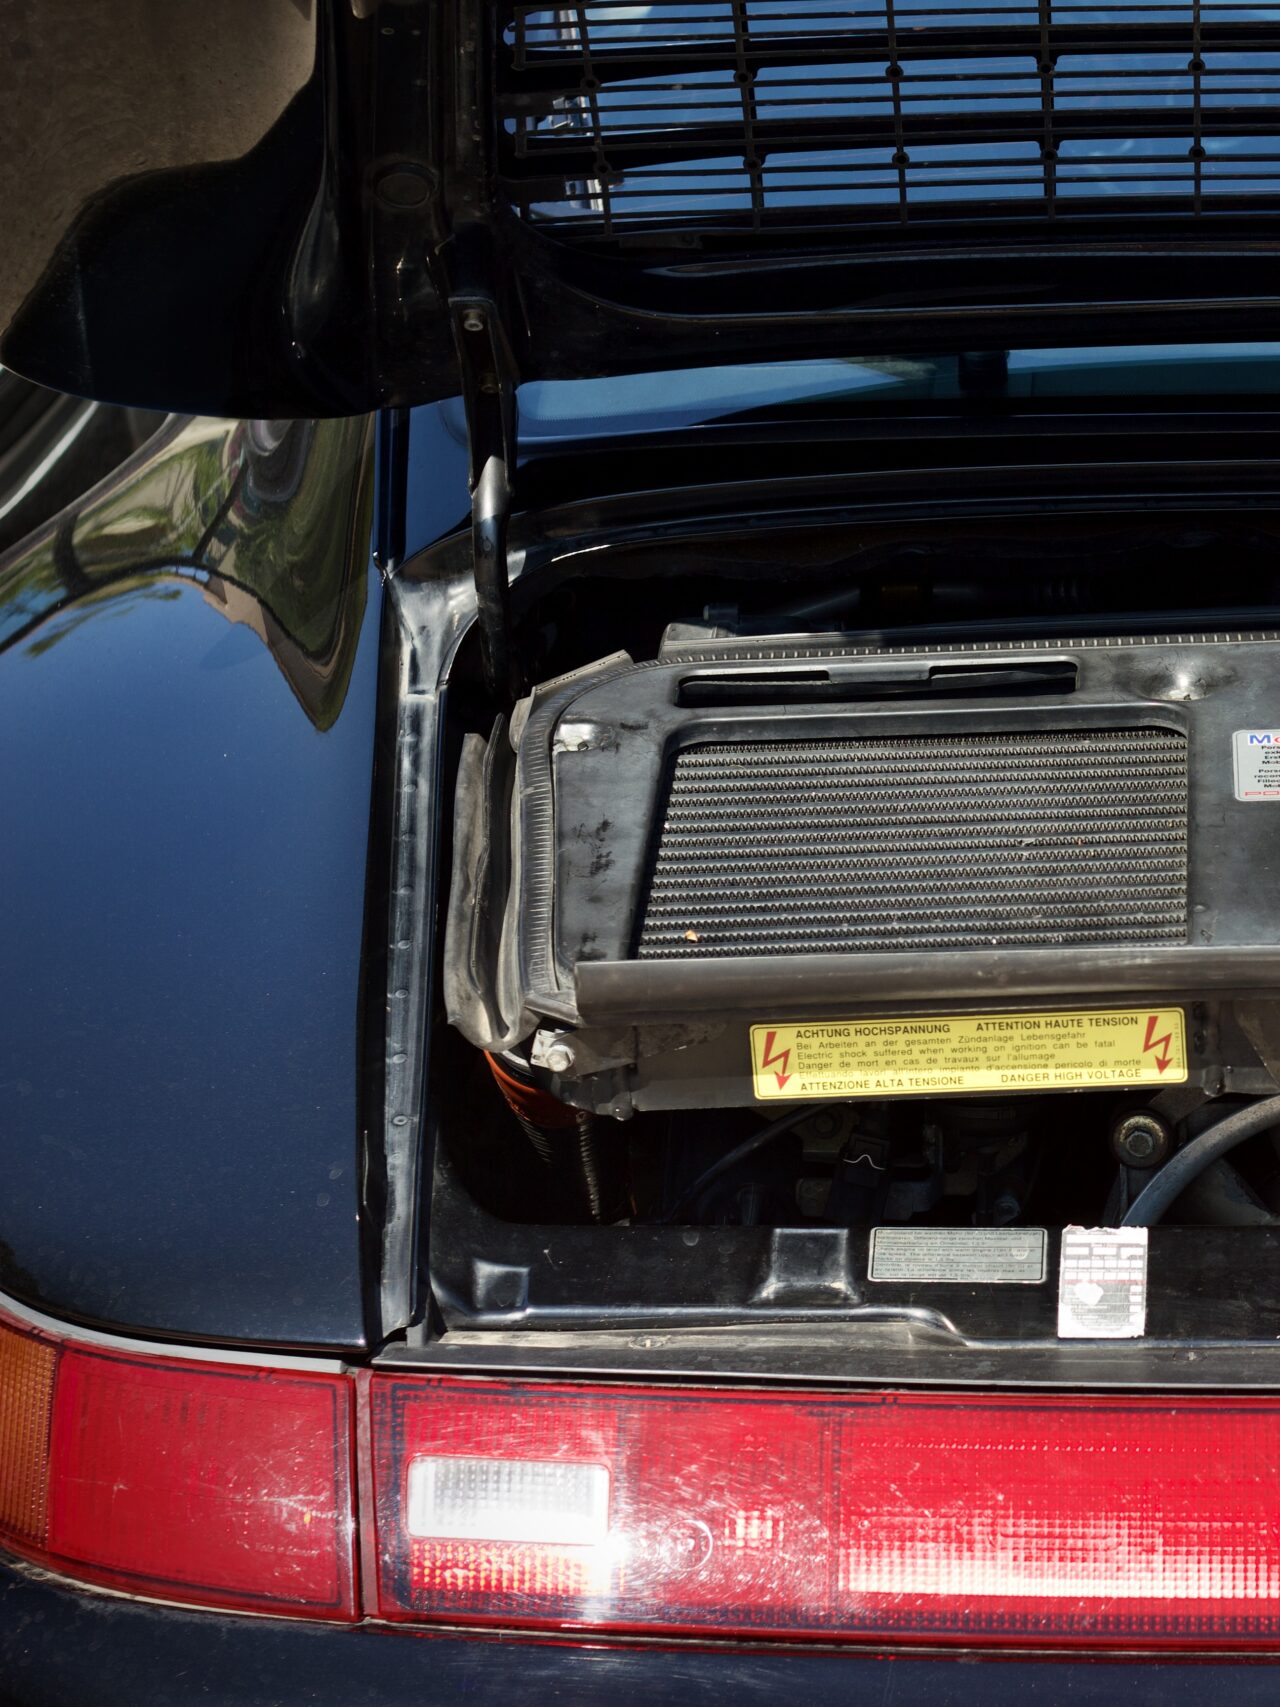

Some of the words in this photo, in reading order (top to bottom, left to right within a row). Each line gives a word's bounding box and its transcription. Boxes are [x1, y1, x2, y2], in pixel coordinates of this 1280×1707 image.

[796, 1028, 851, 1039] ACHTUNG
[854, 1024, 951, 1037] HOCHSPANNUNG
[976, 1021, 1040, 1032] ATTENTION
[1044, 1018, 1084, 1028] HAUTE
[1088, 1016, 1138, 1027] TENSION
[796, 1042, 812, 1050] Bei
[818, 1041, 858, 1050] Arbeiten
[882, 1039, 898, 1048] der
[904, 1037, 951, 1047] gesamten
[958, 1034, 1014, 1045] Zündanlage
[1020, 1032, 1086, 1042] Lebensgefahr
[797, 1051, 833, 1061] Electric
[839, 1050, 868, 1059] shock
[873, 1048, 913, 1057] suffered
[919, 1046, 945, 1055] when
[950, 1045, 988, 1055] working
[1012, 1043, 1047, 1053] ignition
[1053, 1042, 1070, 1050] can
[1094, 1039, 1116, 1048] fatal
[798, 1062, 833, 1071] Danger
[839, 1060, 851, 1068] de
[857, 1059, 880, 1067] mort
[903, 1058, 920, 1066] cas
[926, 1056, 938, 1065] de
[944, 1055, 980, 1064] travaux
[1007, 1051, 1056, 1062] l'allumage
[939, 1065, 980, 1073] impianto
[986, 1061, 1048, 1072] d'accensione
[1055, 1059, 1093, 1070] pericolo
[1099, 1058, 1108, 1067] di
[1114, 1058, 1142, 1067] morte
[800, 1079, 870, 1091] ATTENZIONE
[874, 1078, 904, 1089] ALTA
[908, 1076, 964, 1087] TENSIONE
[1001, 1072, 1050, 1083] DANGER
[1054, 1070, 1083, 1081] HIGH
[1088, 1069, 1142, 1080] VOLTAGE
